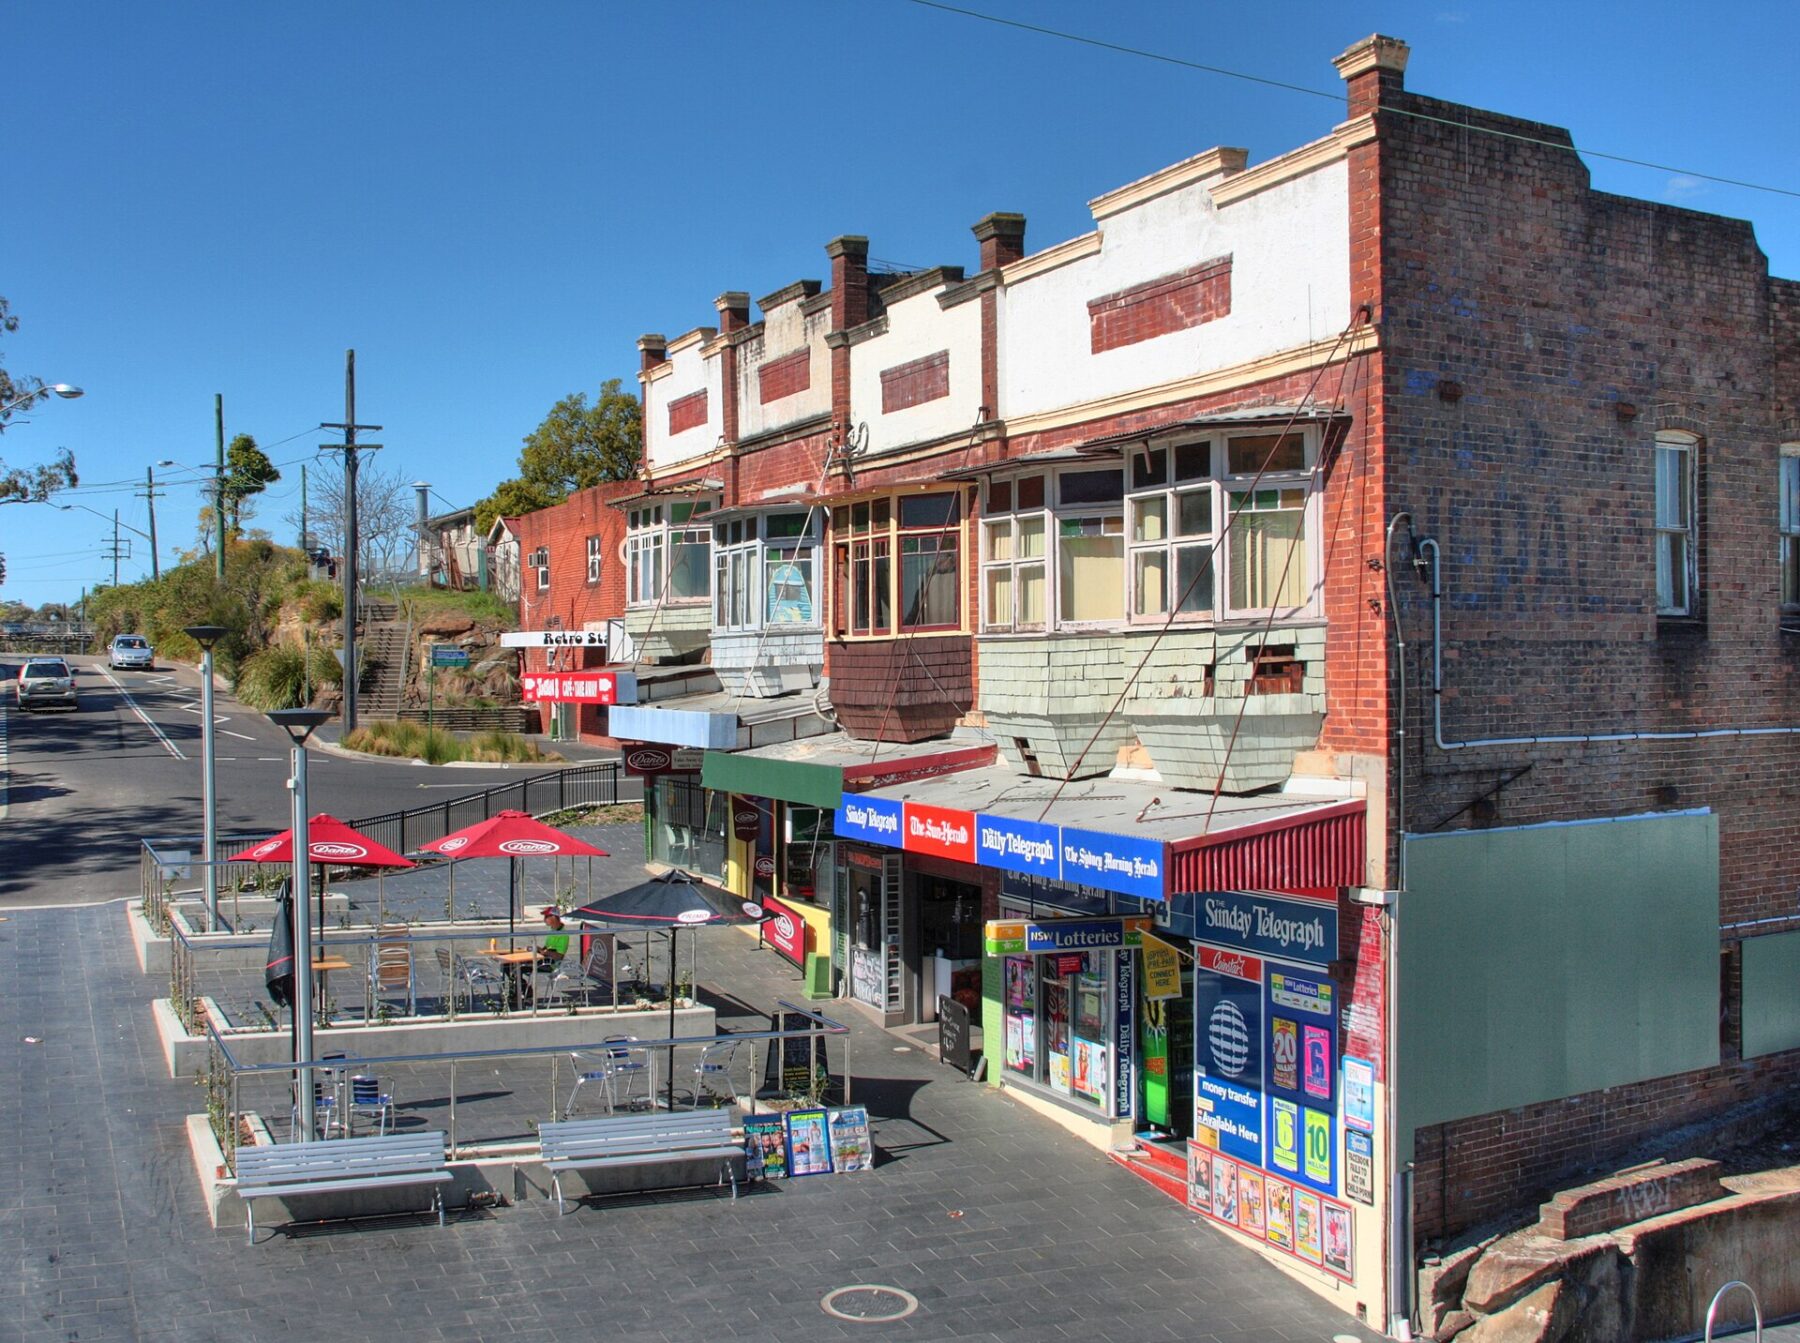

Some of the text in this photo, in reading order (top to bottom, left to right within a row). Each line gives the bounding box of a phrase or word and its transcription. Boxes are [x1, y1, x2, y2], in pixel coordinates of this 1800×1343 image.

[544, 633, 583, 645] Retro
[867, 808, 897, 834] Telegraph
[910, 816, 924, 837] The
[982, 828, 1054, 864] Daily Telegraph
[1064, 846, 1158, 878] The Sydney Morning Herald
[1205, 898, 1325, 951] Sunday Telegraph
[1031, 930, 1119, 947] NSW Lotteries
[1118, 961, 1131, 1012] Telegraph
[1293, 981, 1318, 996] Lotteries
[1117, 1024, 1130, 1113] Daily Telegraph
[1202, 1080, 1227, 1100] money
[1228, 1087, 1257, 1108] transfer
[1203, 1112, 1237, 1135] Available
[1238, 1124, 1258, 1143] Here
[1348, 1152, 1369, 1167] FACEBOOK
[1350, 1163, 1367, 1177] FAILS TO
[1348, 1182, 1371, 1199] CHILD PORN
[1351, 1173, 1366, 1186] ACT ON
